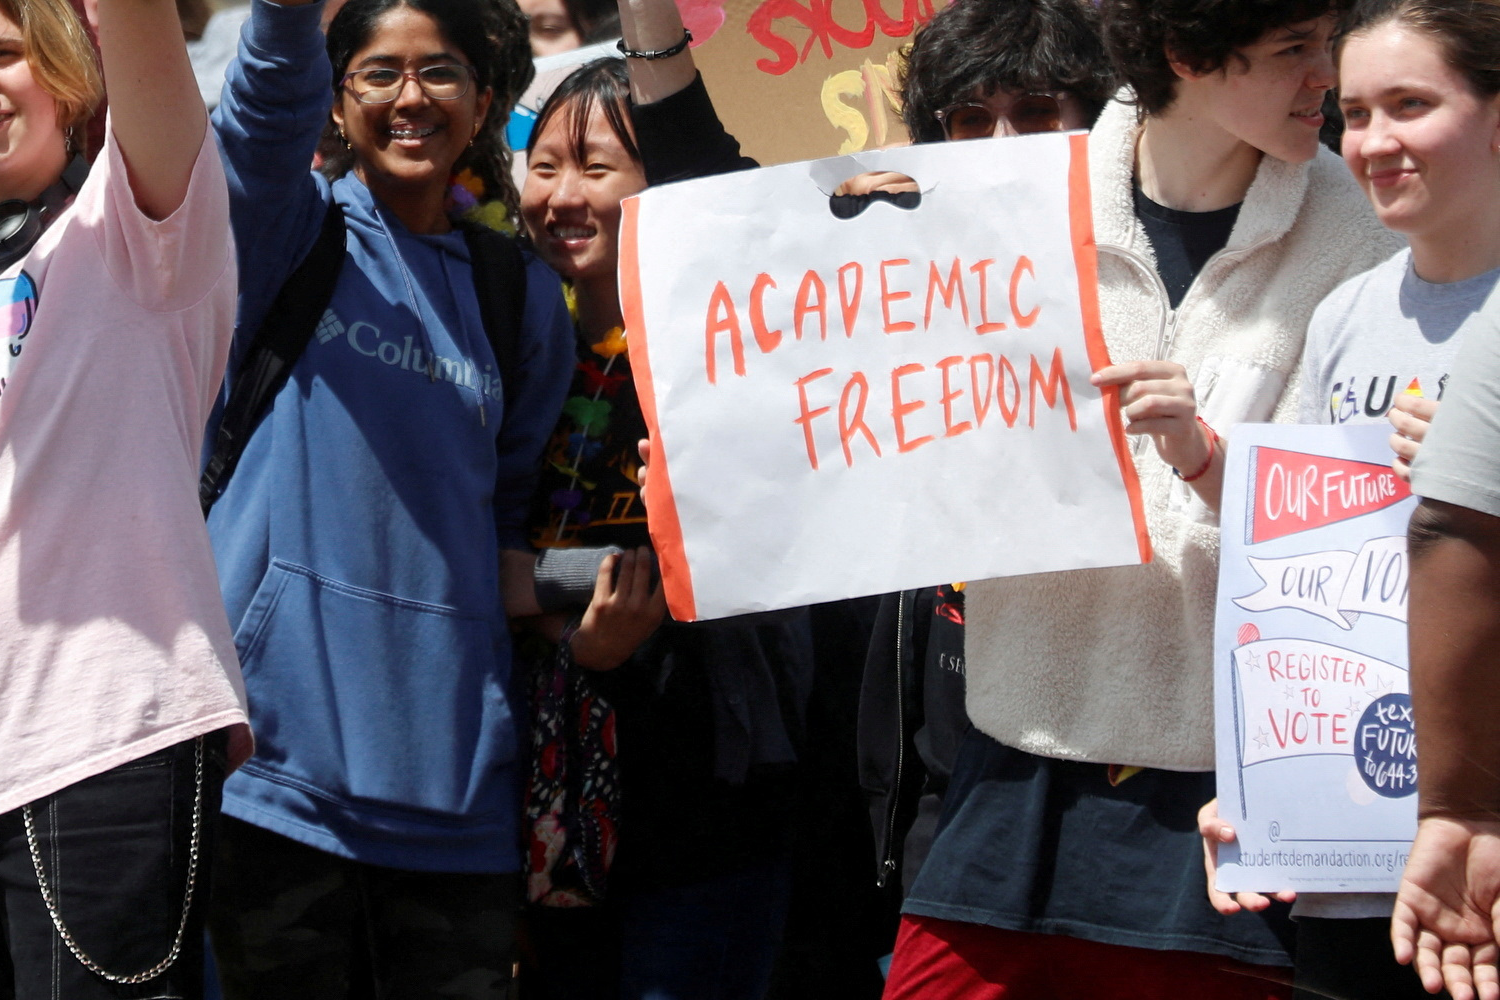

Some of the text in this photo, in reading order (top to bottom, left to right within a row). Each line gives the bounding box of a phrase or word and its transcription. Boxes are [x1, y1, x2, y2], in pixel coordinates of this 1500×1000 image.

[704, 255, 1042, 386] ACADEMIC
[346, 321, 502, 399] Columbia
[793, 346, 1077, 471] FREEDOM
[1264, 463, 1320, 521] OUR
[1281, 565, 1334, 607] OUR
[1267, 650, 1366, 687] REGISTER
[1300, 687, 1322, 708] TO
[1375, 702, 1414, 730] tex
[1268, 708, 1349, 750] VOTE
[1364, 751, 1418, 789] to 644-3
[1238, 848, 1411, 873] studentsdemandaction.org/re
